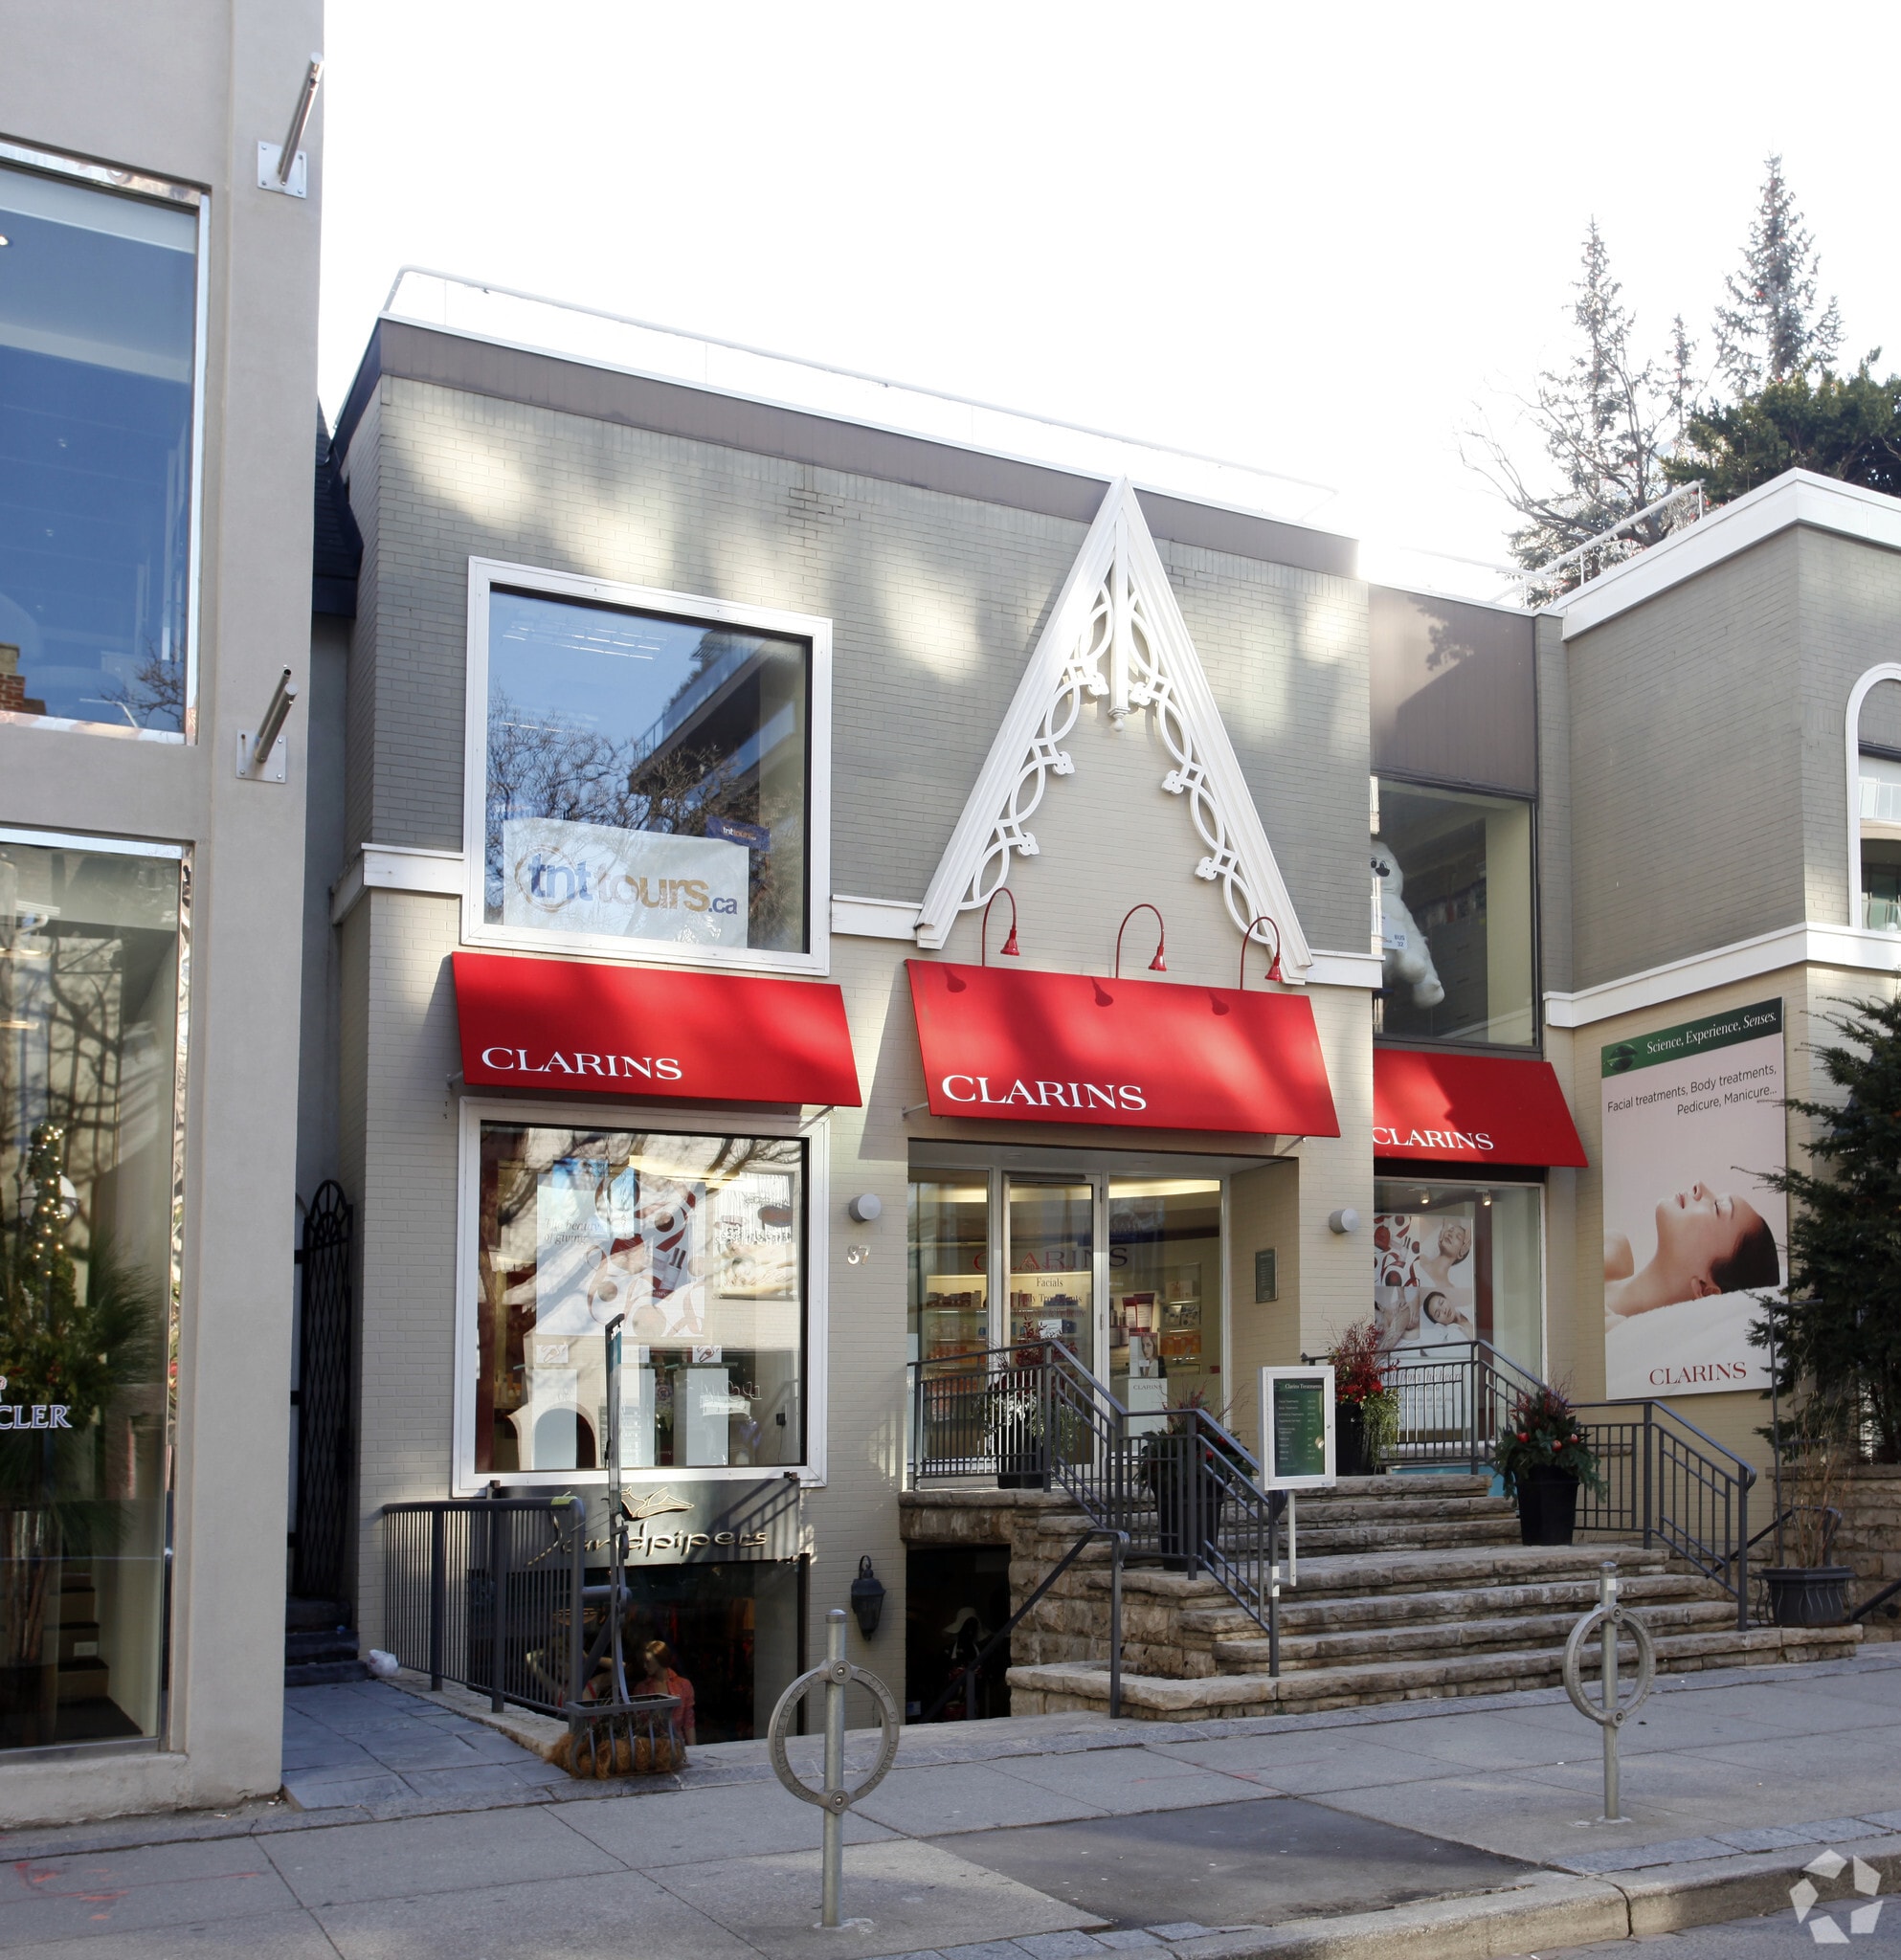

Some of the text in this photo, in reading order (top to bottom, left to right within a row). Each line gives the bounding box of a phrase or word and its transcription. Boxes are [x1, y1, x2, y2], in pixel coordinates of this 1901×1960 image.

[1647, 1011, 1777, 1055] Science, Experience, Senses.
[481, 1047, 682, 1080] CLARINS
[942, 1075, 1147, 1111] CLARINS
[1607, 1064, 1777, 1113] Facial treatments, Body treatments,
[1677, 1087, 1778, 1116] Pedicure, Manicure...
[1372, 1126, 1494, 1150] CLARINS
[1036, 1277, 1063, 1287] Facials
[1647, 1361, 1747, 1386] CLARINS
